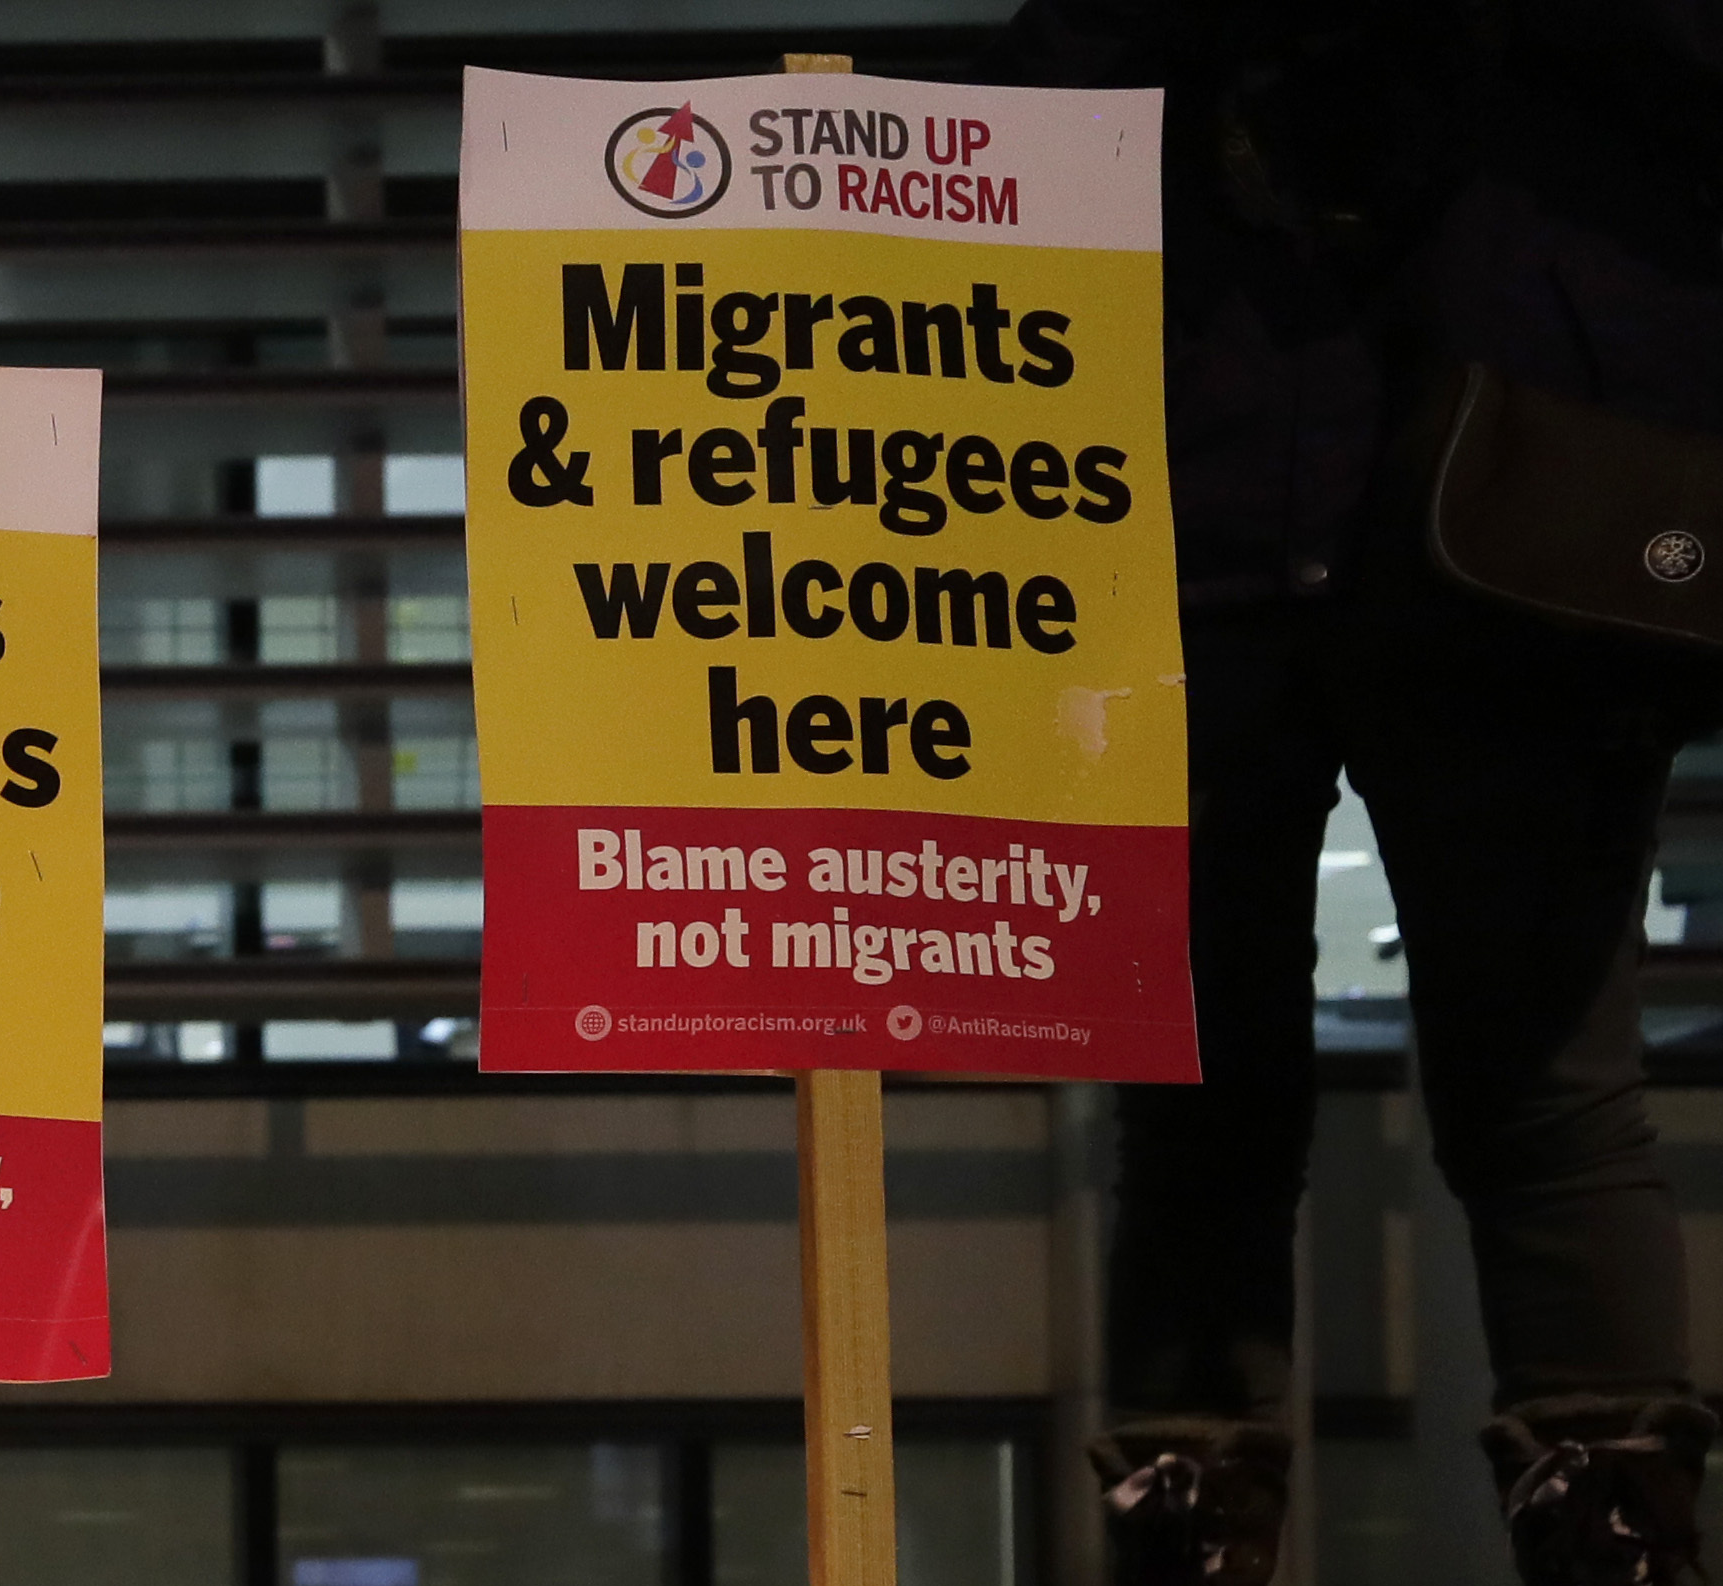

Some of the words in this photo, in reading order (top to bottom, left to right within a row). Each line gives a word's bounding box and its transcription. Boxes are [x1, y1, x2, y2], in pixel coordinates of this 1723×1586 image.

[749, 109, 909, 162] STAND
[925, 118, 991, 168] UP
[751, 162, 821, 211] TO
[838, 166, 1018, 225] RACISM
[562, 262, 1075, 399] Migrants
[507, 395, 593, 508] &
[632, 397, 1132, 537] refugees
[573, 531, 1077, 655] welcome
[708, 665, 972, 780] here
[577, 828, 786, 893] Blame
[808, 840, 1101, 922] austerity,
[636, 907, 749, 969] not
[772, 907, 1055, 985] migrants
[617, 1012, 866, 1037] standuptoracism.org.uk
[928, 1013, 1091, 1045] @AntiRacismDay
